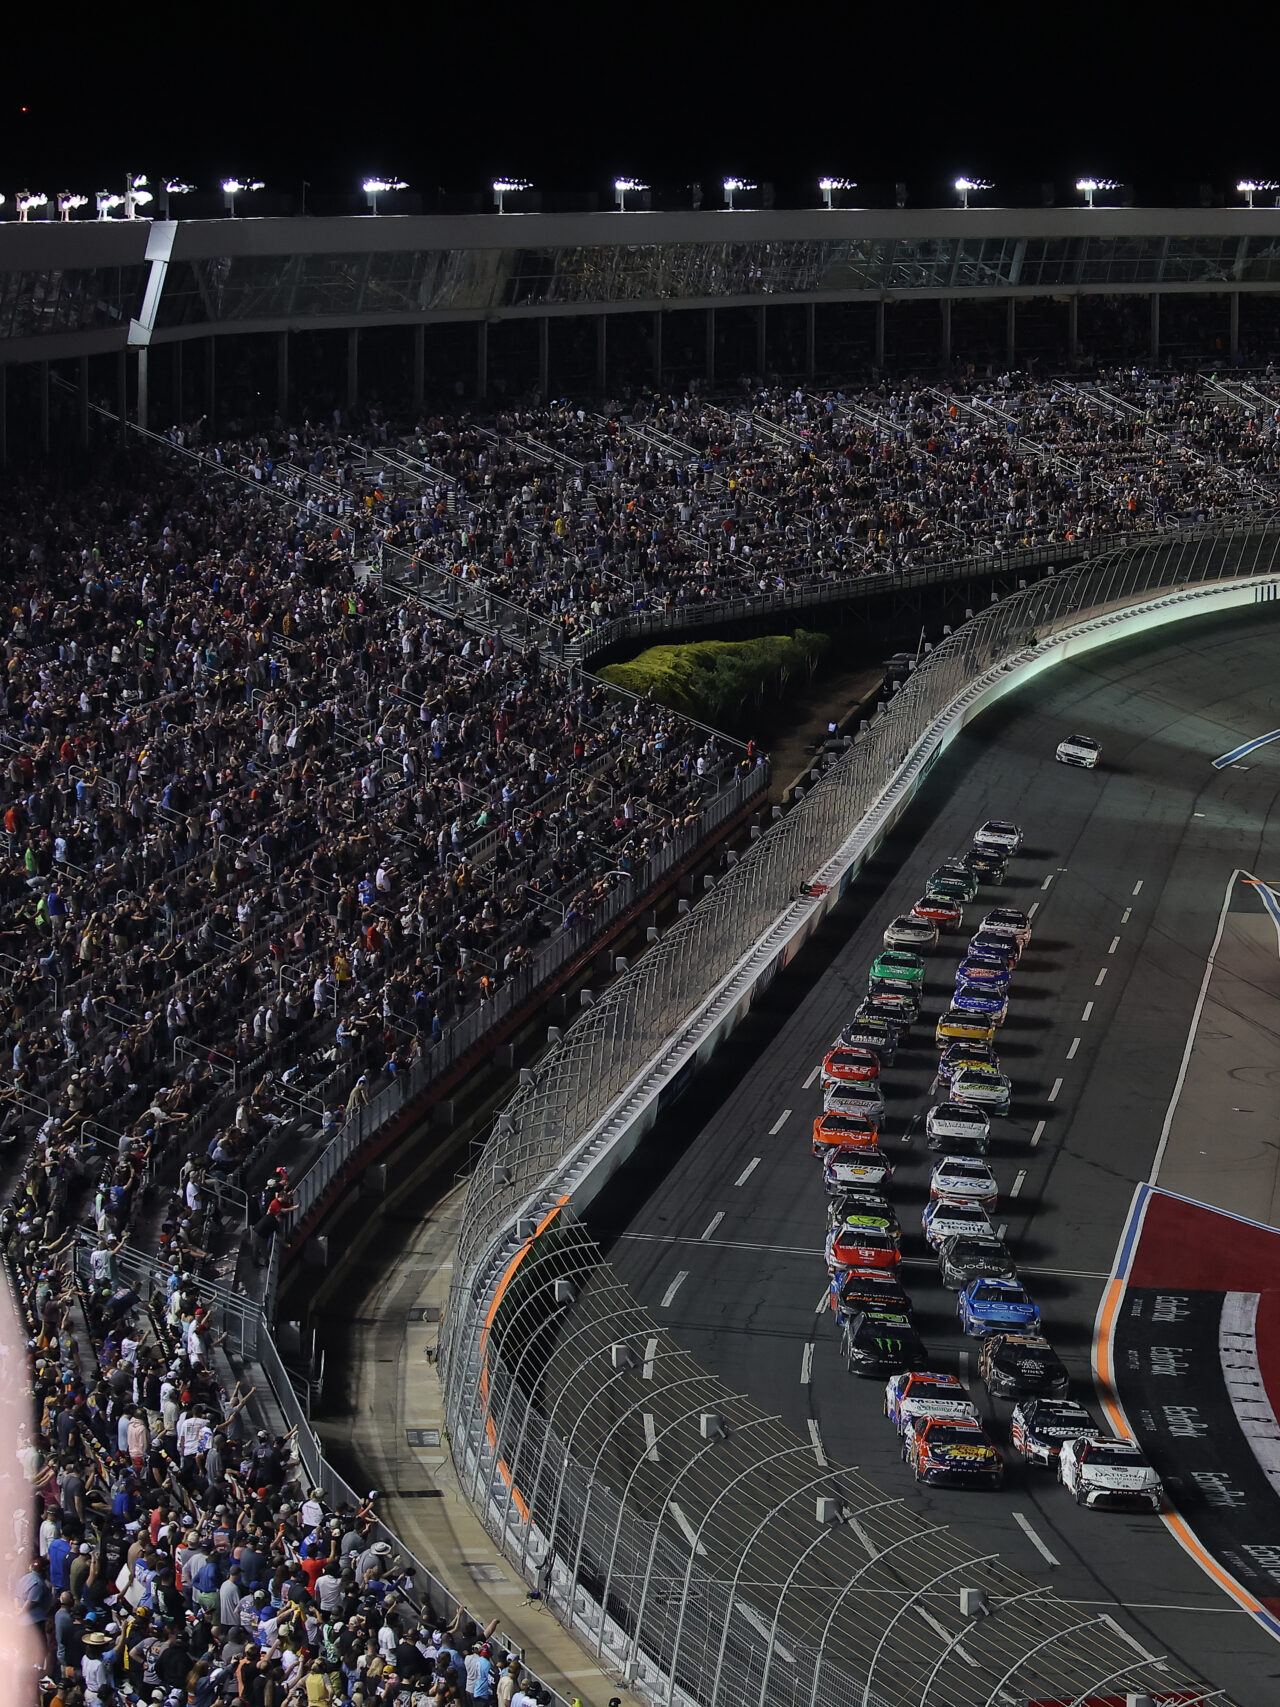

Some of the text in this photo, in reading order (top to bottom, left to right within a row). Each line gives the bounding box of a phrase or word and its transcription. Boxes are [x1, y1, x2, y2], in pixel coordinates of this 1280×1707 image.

[959, 1264, 1006, 1272] JOCKEY
[1152, 1295, 1191, 1322] EchoPark
[1162, 1405, 1209, 1438] EchoPark
